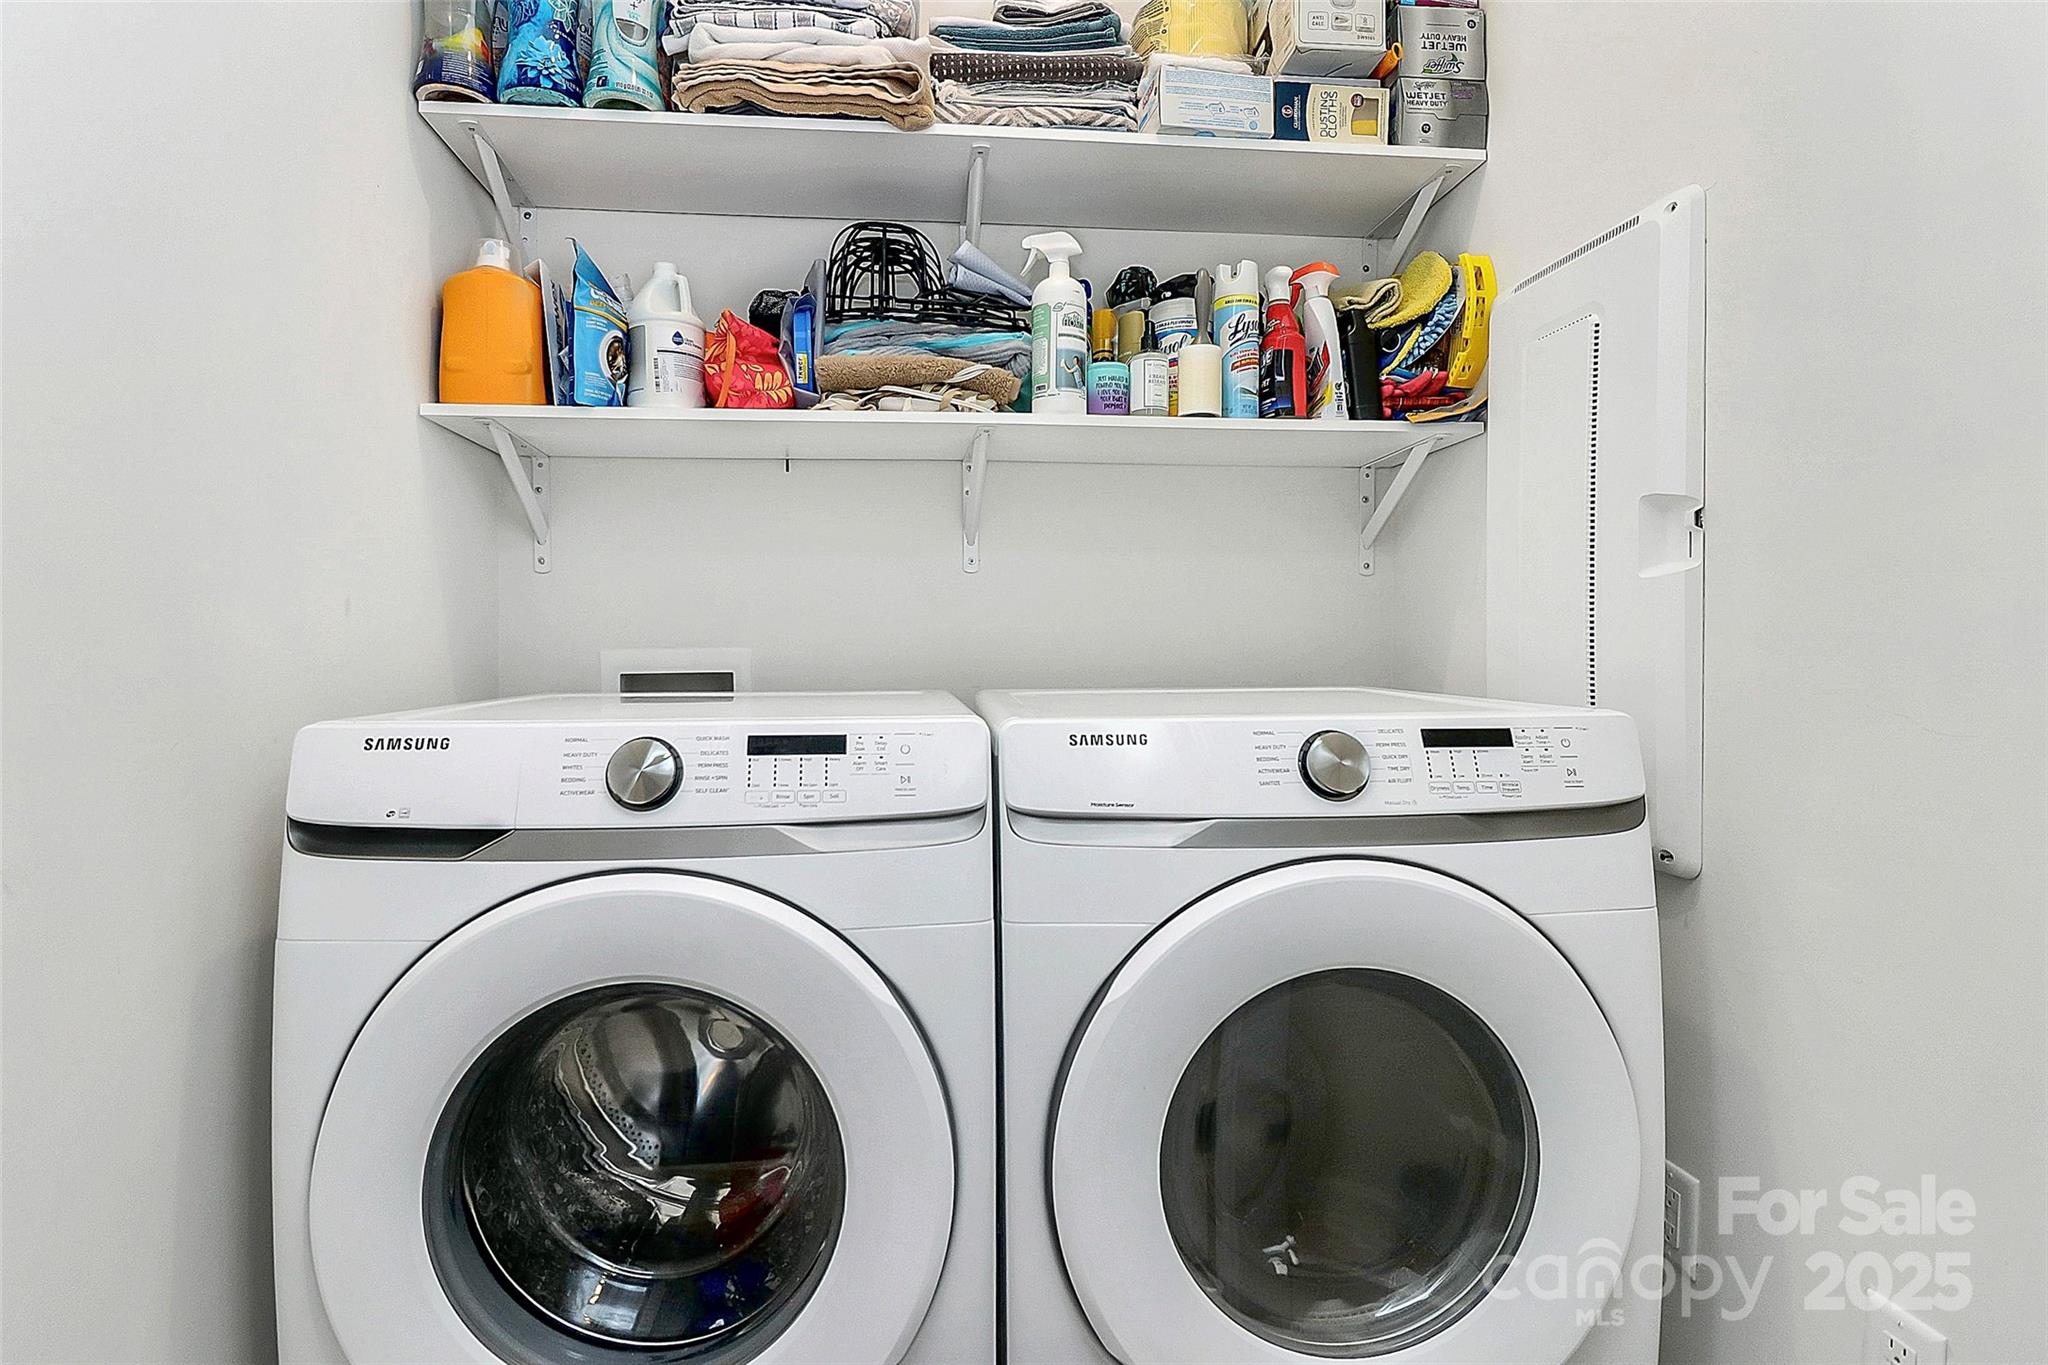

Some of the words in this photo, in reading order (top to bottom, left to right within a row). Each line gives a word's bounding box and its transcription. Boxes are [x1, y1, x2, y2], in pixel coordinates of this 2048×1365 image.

[1420, 32, 1441, 40] DUTY
[1442, 34, 1467, 42] HEAVY
[1421, 40, 1467, 51] WETJET
[1422, 54, 1465, 75] Swiffer
[1406, 91, 1447, 101] WETJET
[1319, 91, 1329, 138] DUSTING
[1328, 90, 1339, 139] CLOTHS
[363, 737, 451, 751] SAMSUNG
[1069, 733, 1148, 747] SAMSUNG
